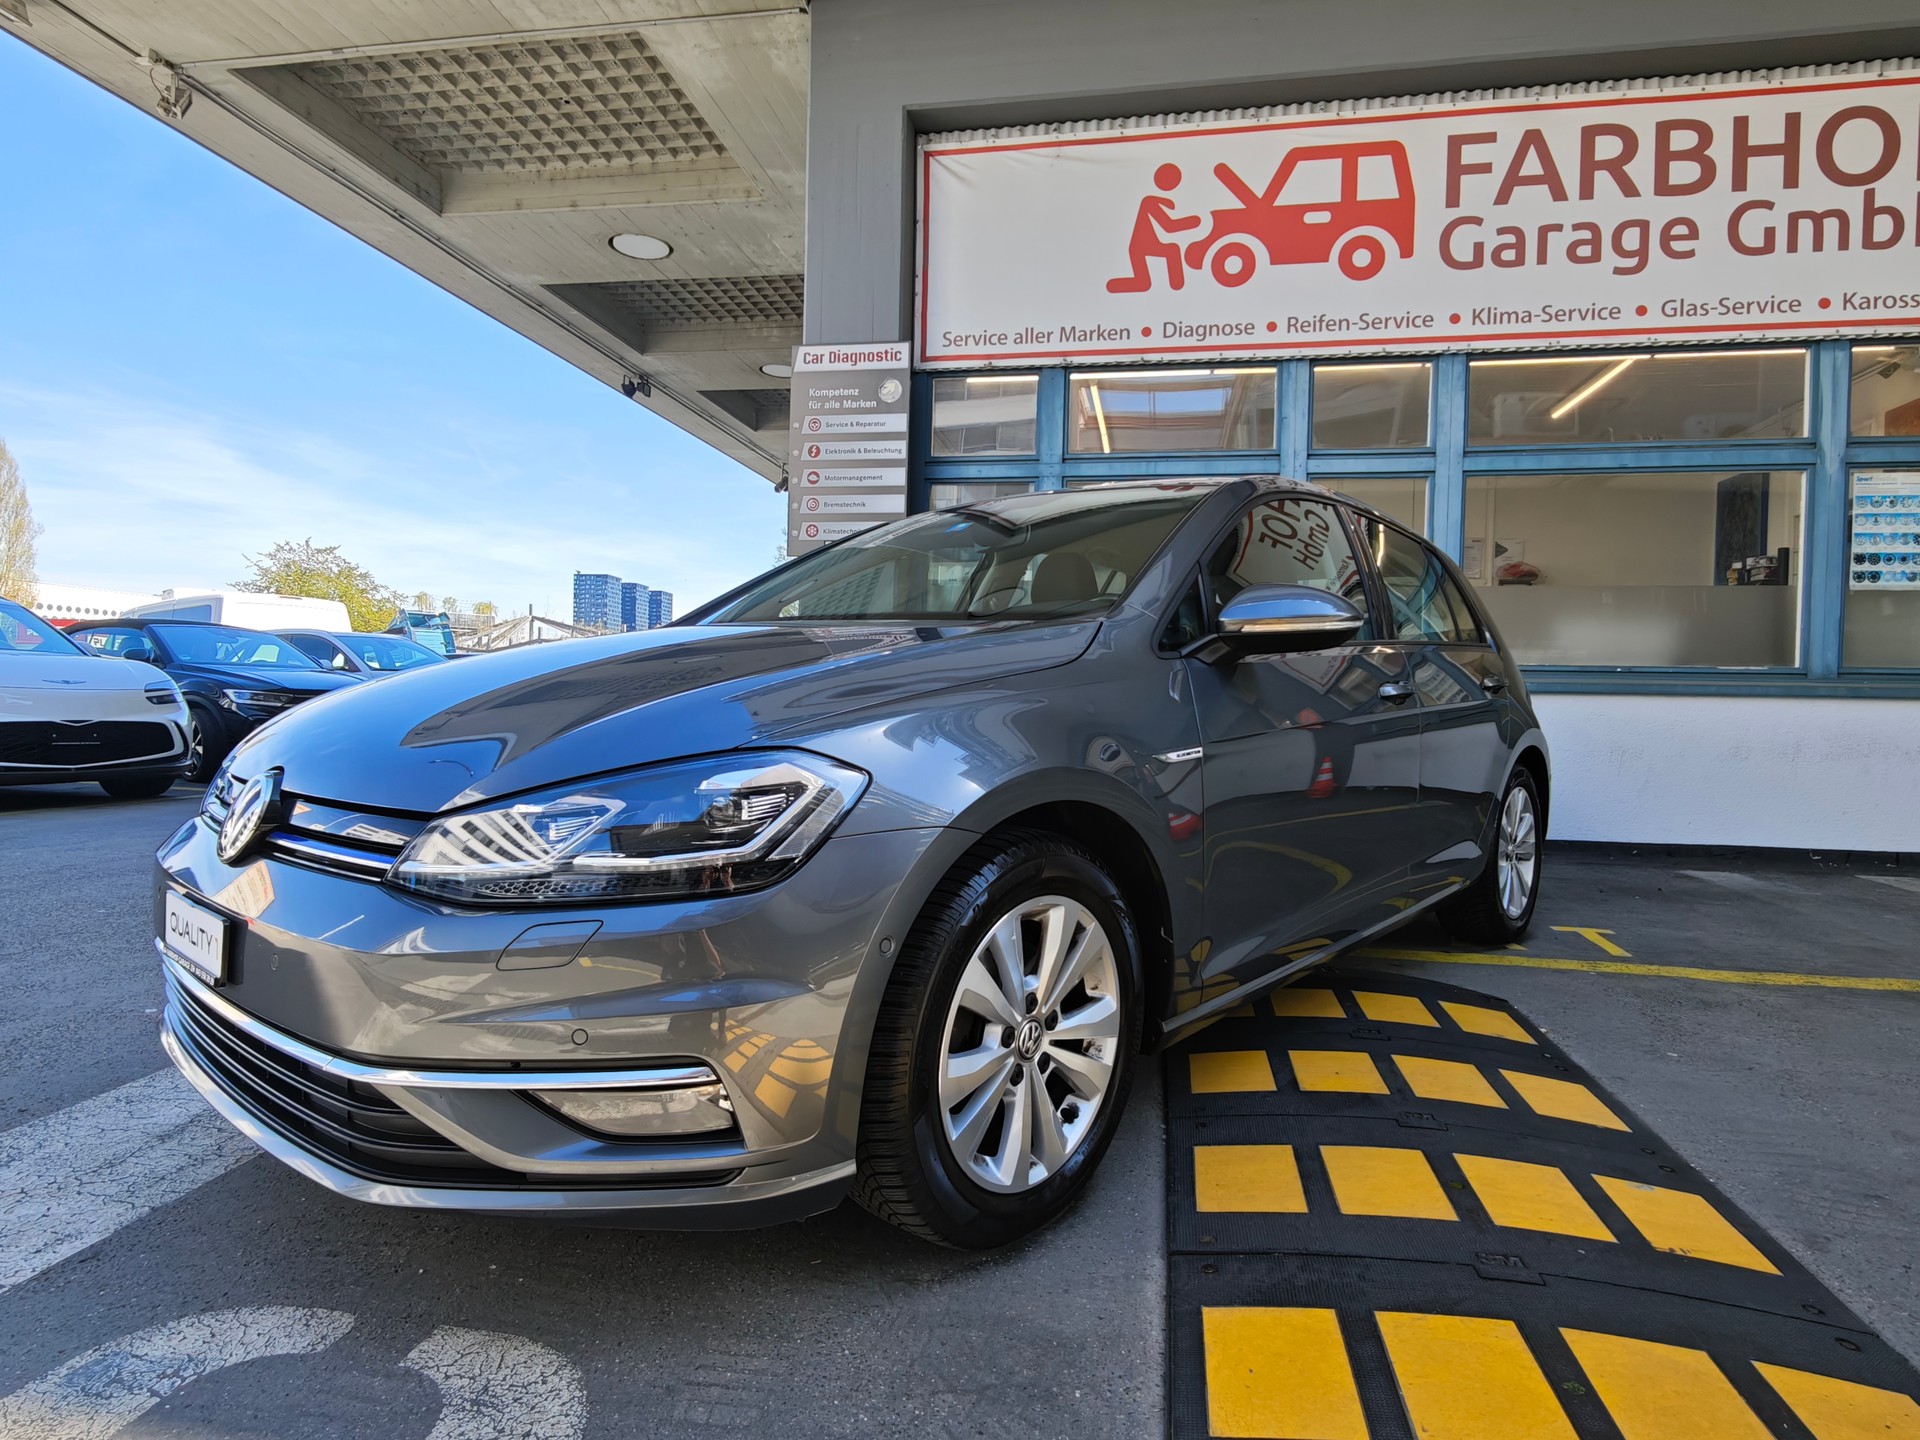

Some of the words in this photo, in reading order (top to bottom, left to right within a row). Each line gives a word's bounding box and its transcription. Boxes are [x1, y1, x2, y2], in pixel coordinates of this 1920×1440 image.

[1444, 104, 1920, 208] FARBHO
[1438, 215, 1700, 276] Garage
[1727, 187, 1920, 256] Gmb
[942, 329, 1008, 348] Service
[1012, 326, 1055, 345] aller
[1058, 324, 1131, 344] Marken
[1162, 319, 1255, 342] Diagnose
[1285, 311, 1435, 334] Reifen-Service
[1471, 303, 1622, 326] Klima-Service
[1660, 296, 1802, 319] Glas-Service
[1841, 291, 1920, 311] Kaross
[803, 351, 825, 365] Car
[828, 347, 902, 366] Diagnostic
[809, 387, 859, 398] Kompetenz
[808, 399, 822, 410] für
[824, 399, 840, 409] alle
[843, 399, 877, 409] Marken
[825, 420, 848, 428] Service
[855, 420, 886, 428] Reparatur
[824, 447, 856, 455] Elektronik
[863, 447, 902, 455] Beleuchtung
[824, 474, 883, 482] Motormanagement
